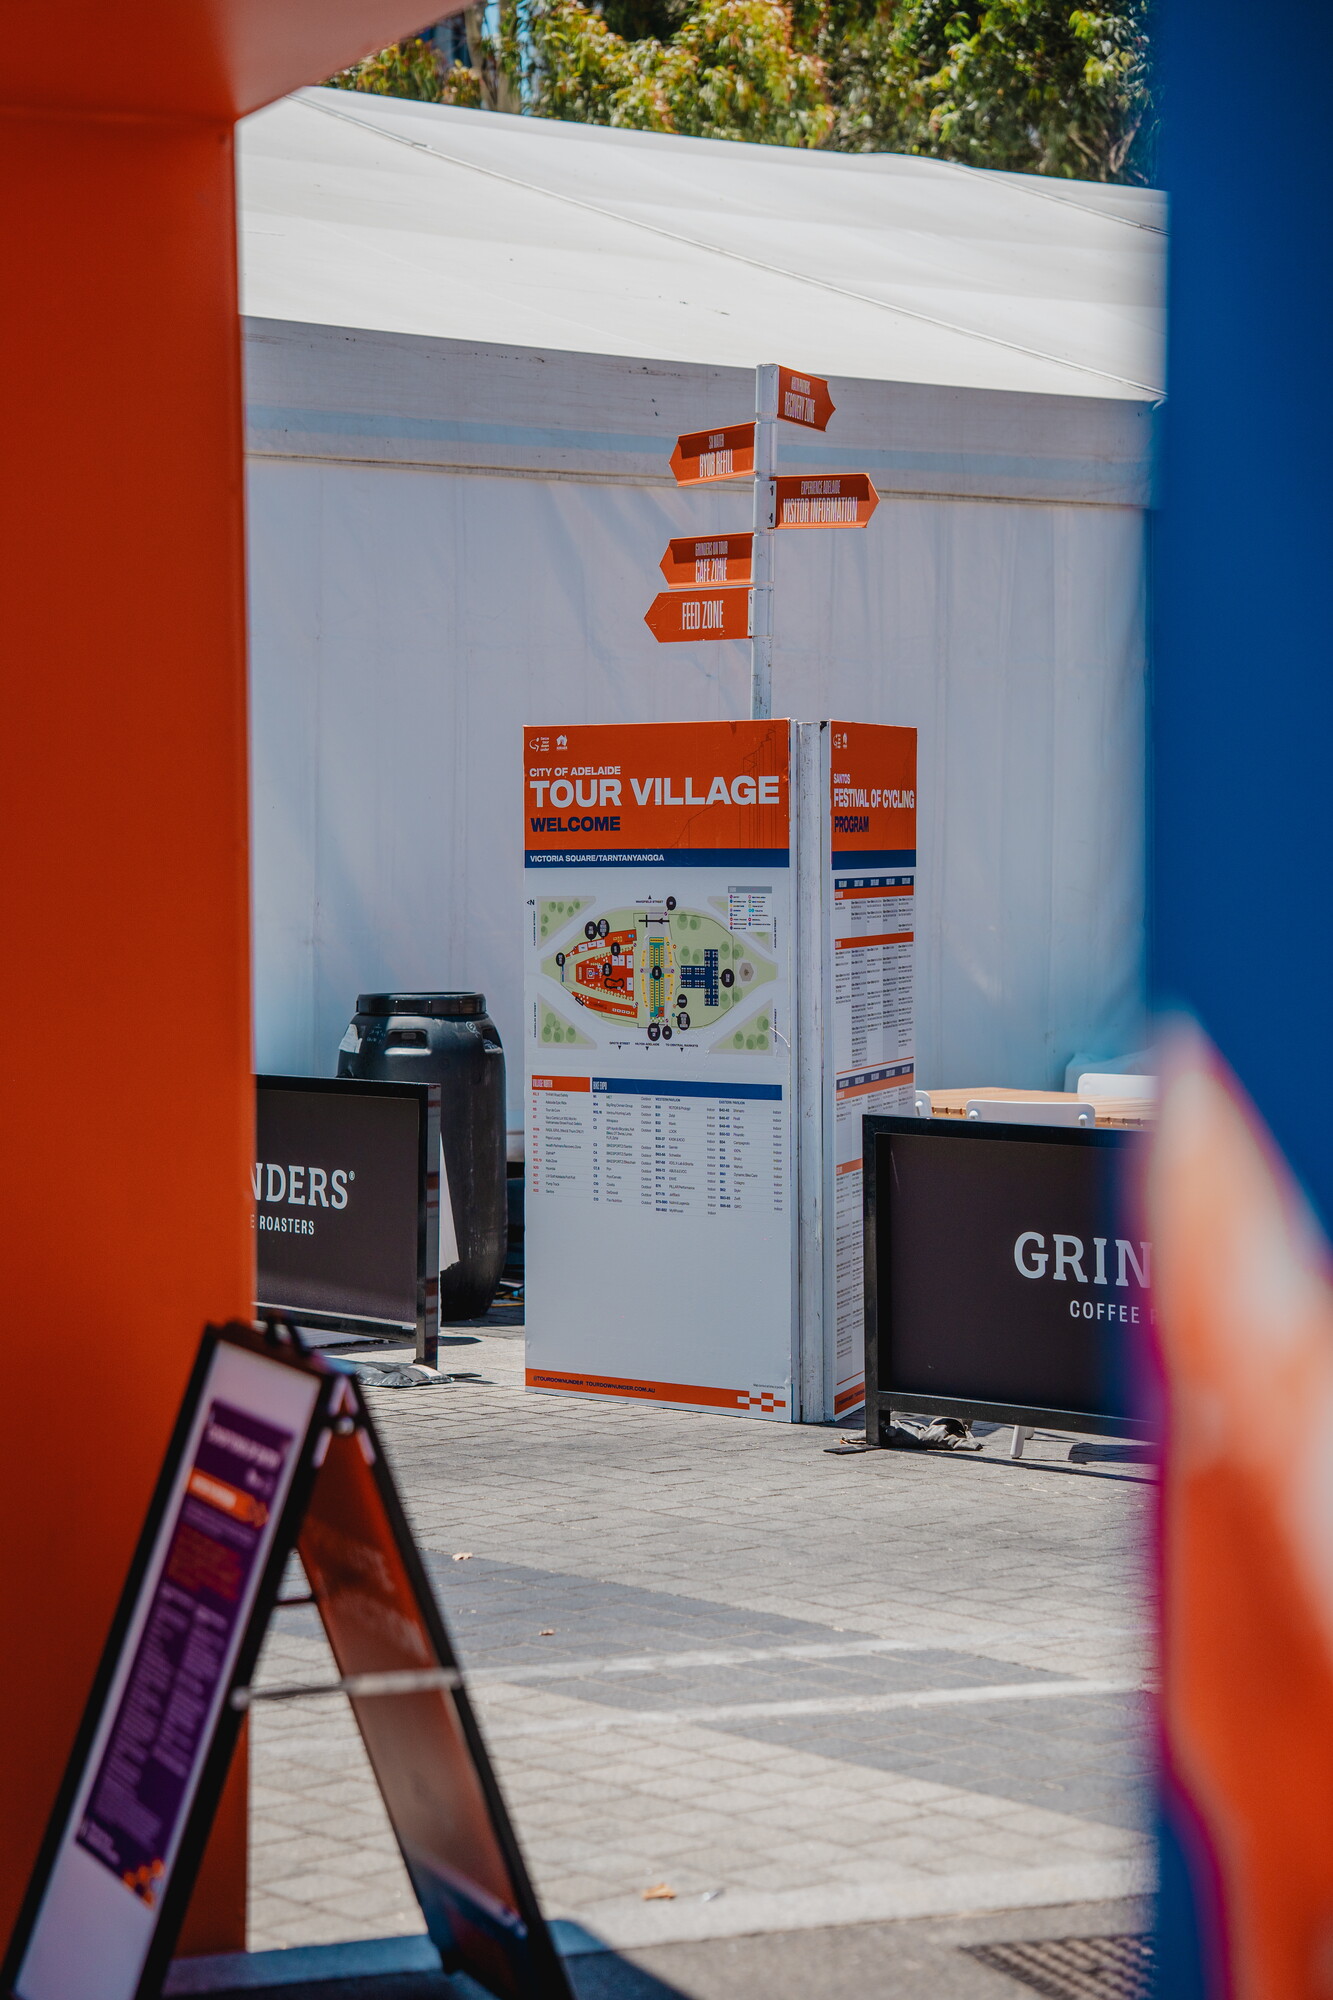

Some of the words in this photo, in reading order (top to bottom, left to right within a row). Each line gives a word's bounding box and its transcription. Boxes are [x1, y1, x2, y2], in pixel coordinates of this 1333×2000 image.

[805, 398, 815, 424] ZONE
[700, 452, 715, 477] BYOB
[716, 449, 734, 475] REFILL
[801, 480, 822, 494] EXPERIENCE
[784, 498, 808, 522] VISITOR
[810, 497, 857, 522] INFORMATION
[696, 558, 710, 583] CAFE
[711, 558, 727, 582] ZONE
[682, 602, 700, 629] FEED
[702, 600, 724, 629] ZONE
[530, 768, 552, 777] CITY
[554, 767, 568, 776] OF
[570, 766, 621, 776] ADELAIDE
[834, 774, 850, 784] SANTOS
[530, 779, 622, 808] TOUR
[630, 775, 780, 806] VILLAGE
[834, 788, 869, 808] FESTIVAL
[871, 789, 881, 808] OF
[883, 789, 915, 809] CYCLING
[530, 816, 620, 832] WELCOME
[834, 816, 869, 833] PROGRAM
[530, 854, 564, 863] VICTORIA
[565, 854, 664, 862] SQUARE/TARNTANYANGGA
[259, 1216, 315, 1236] ROASTERS
[1014, 1231, 1153, 1288] GRIN
[1070, 1300, 1140, 1324] COFFEE
[533, 1375, 583, 1385] @TOURDOWNUNDER
[586, 1381, 656, 1393] TOURDOWNUNDER.COM.AU
